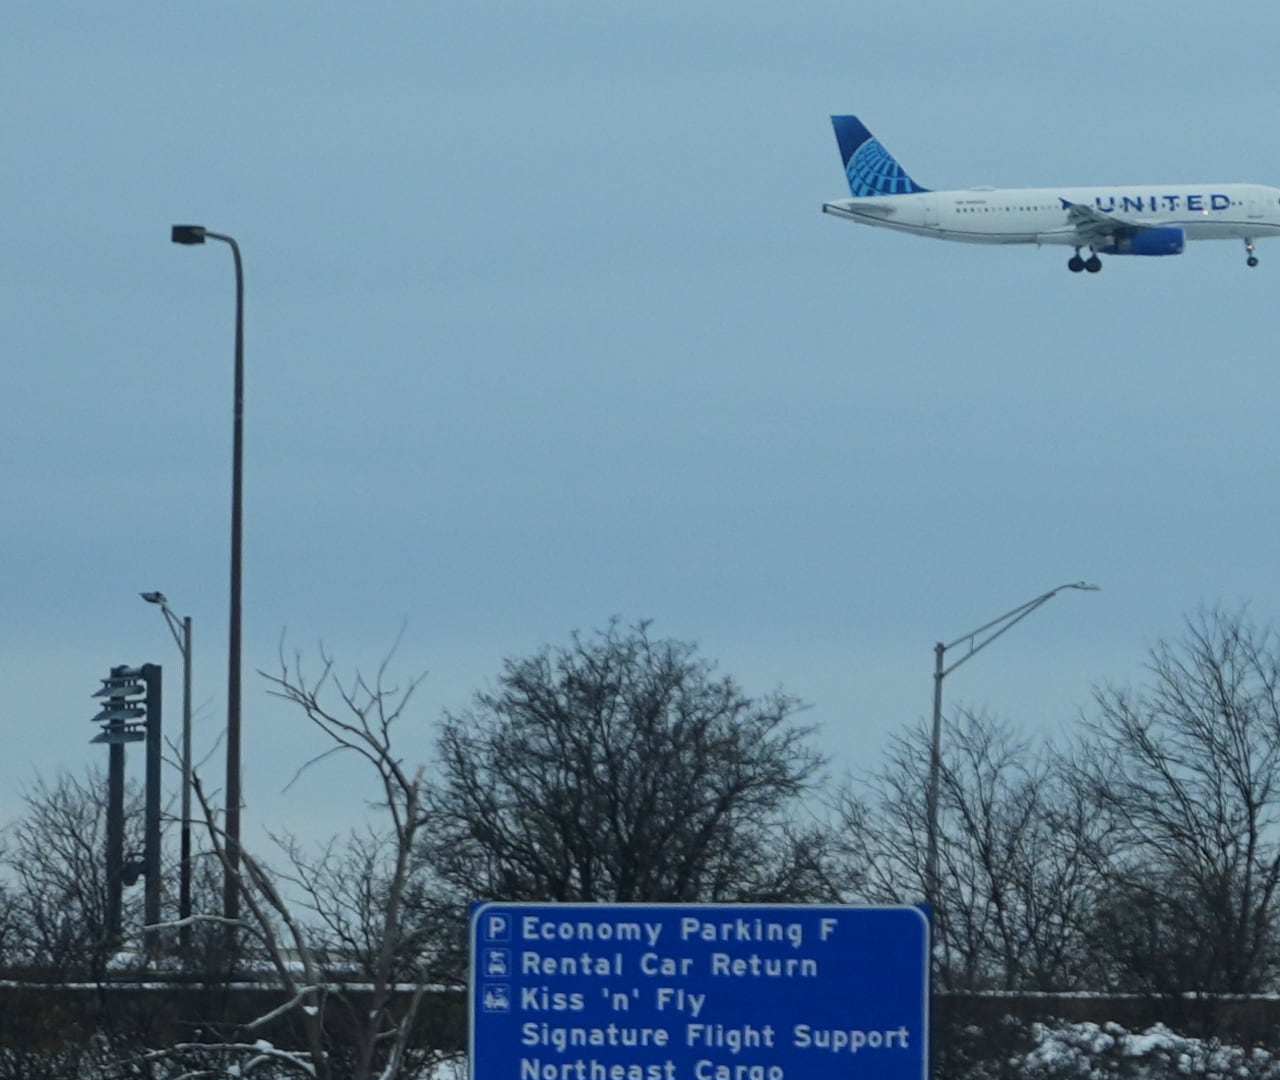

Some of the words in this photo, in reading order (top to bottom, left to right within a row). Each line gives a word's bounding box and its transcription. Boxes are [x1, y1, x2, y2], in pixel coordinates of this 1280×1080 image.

[1095, 194, 1231, 213] UNITED
[522, 916, 662, 946] Economy
[682, 918, 802, 947] Parking
[821, 918, 838, 941] F
[522, 951, 622, 975] Rental
[641, 953, 693, 975] Car
[713, 953, 817, 976] Return
[521, 986, 584, 1010] Kiss
[603, 988, 639, 1010] 'n'
[657, 988, 705, 1016] Fly
[522, 1023, 669, 1052] Signature
[687, 1024, 775, 1053] Flight
[794, 1025, 909, 1053] Support
